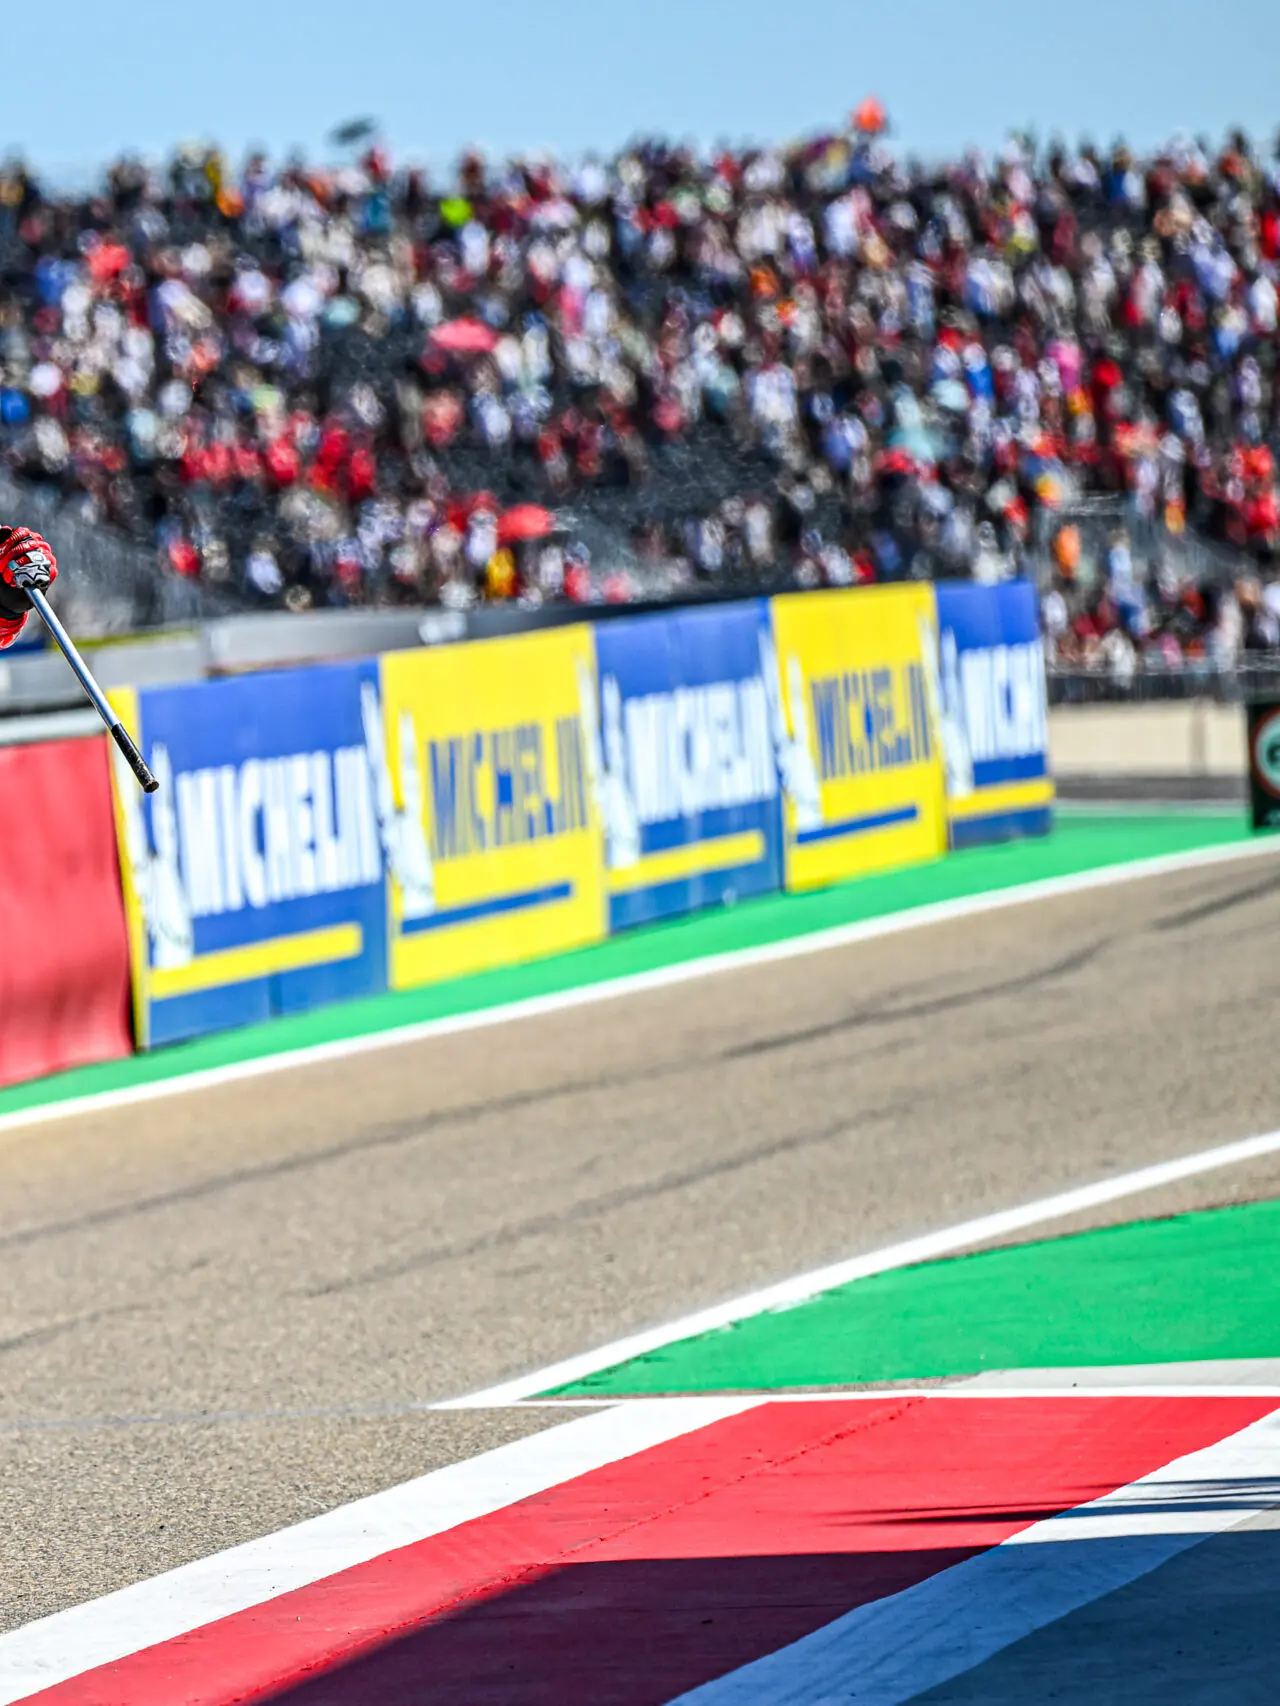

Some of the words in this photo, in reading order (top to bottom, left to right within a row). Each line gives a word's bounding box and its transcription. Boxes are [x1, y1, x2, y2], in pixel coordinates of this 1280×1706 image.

[429, 714, 588, 862] MICHELIN
[625, 675, 777, 825] MICHELIN
[810, 661, 931, 781] MICHELIN
[176, 744, 382, 918] MICHELIN
